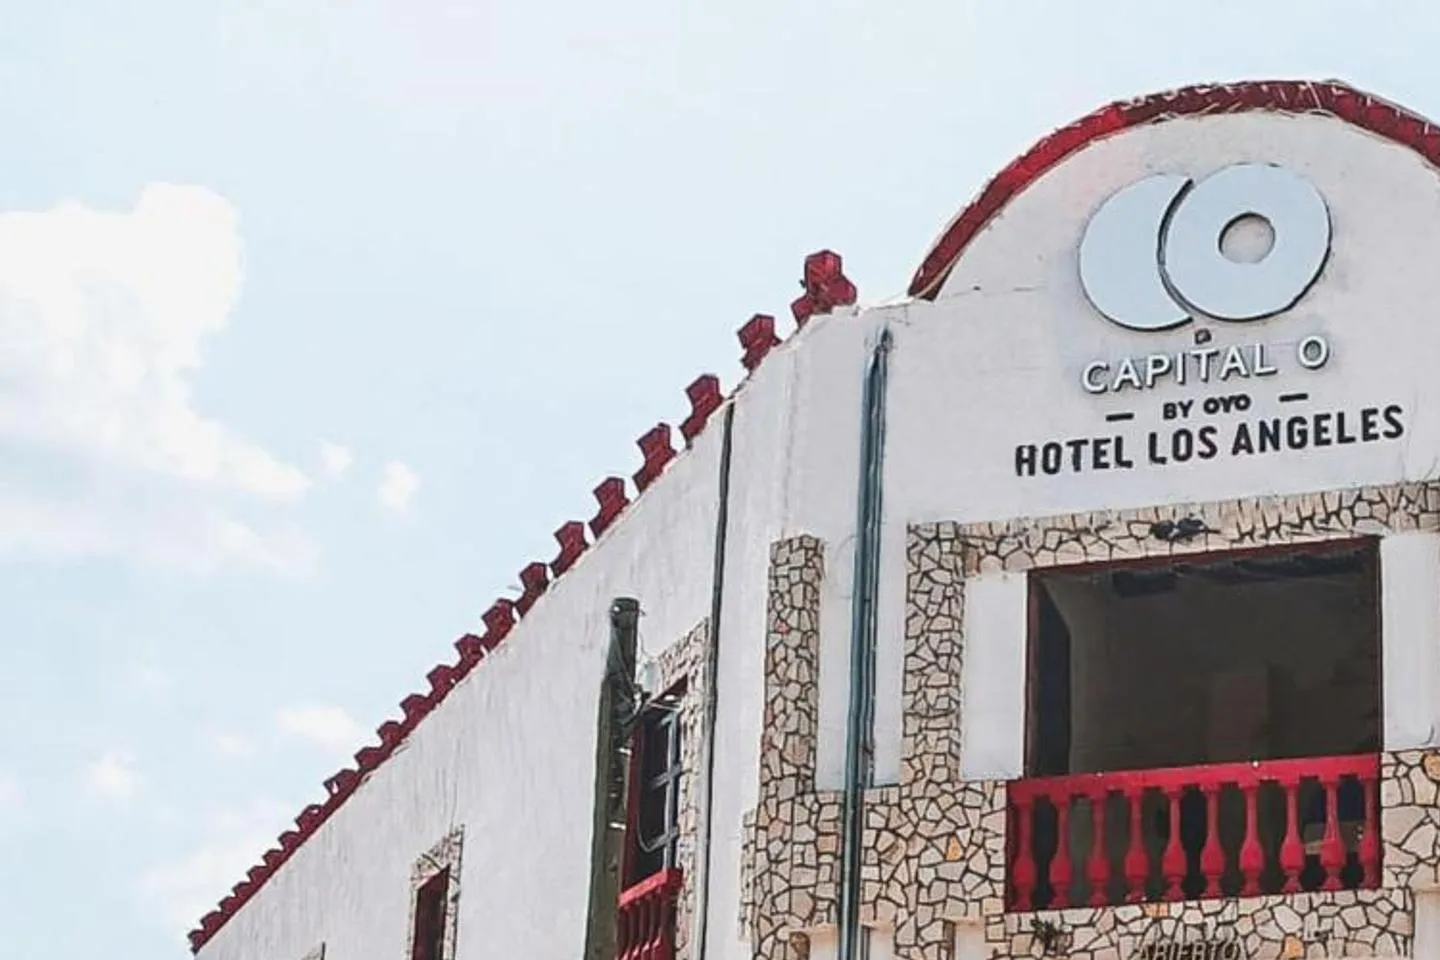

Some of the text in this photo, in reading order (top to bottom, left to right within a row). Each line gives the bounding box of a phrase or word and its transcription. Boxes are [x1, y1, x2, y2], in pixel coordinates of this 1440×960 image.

[1082, 336, 1329, 393] CAPITAL O
[1163, 394, 1251, 420] BY OYO
[1014, 405, 1405, 477] HOTEL LOS ANGELES
